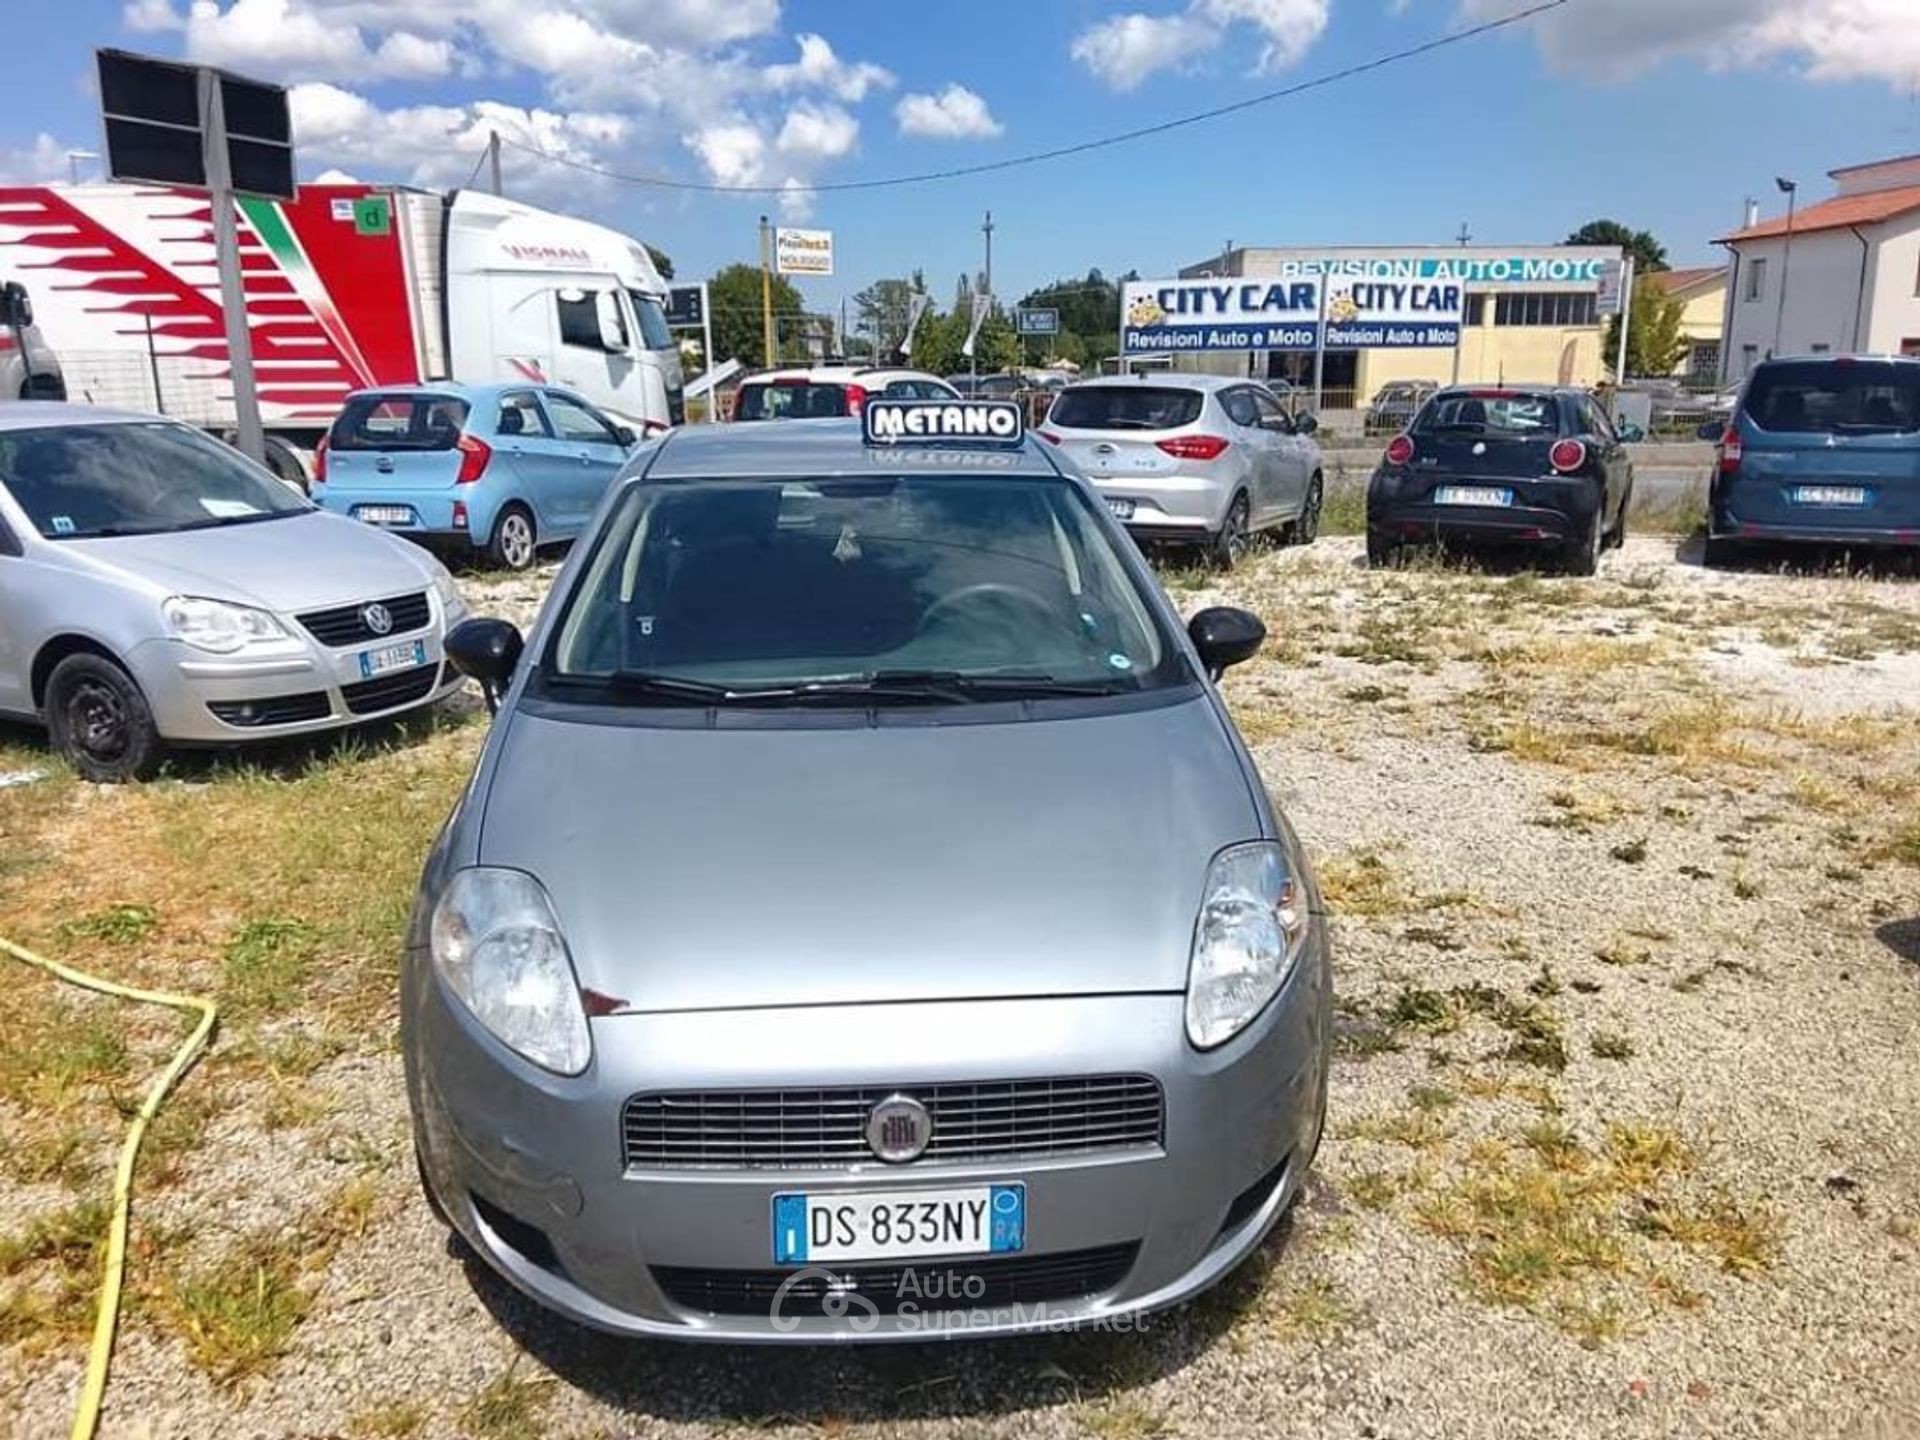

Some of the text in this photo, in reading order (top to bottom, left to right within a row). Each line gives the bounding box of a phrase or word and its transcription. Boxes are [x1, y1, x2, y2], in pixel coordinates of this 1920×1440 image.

[1281, 260, 1421, 279] REVISIONI
[1158, 282, 1316, 313] CITY CAR
[1351, 283, 1460, 311] CITY CAR
[1127, 330, 1314, 348] Revisioni Auto e Moto
[1327, 327, 1457, 344] Revisioni Auto e Moto
[874, 406, 1015, 435] METANO
[810, 1205, 856, 1248] DS
[870, 1199, 987, 1245] 833NY
